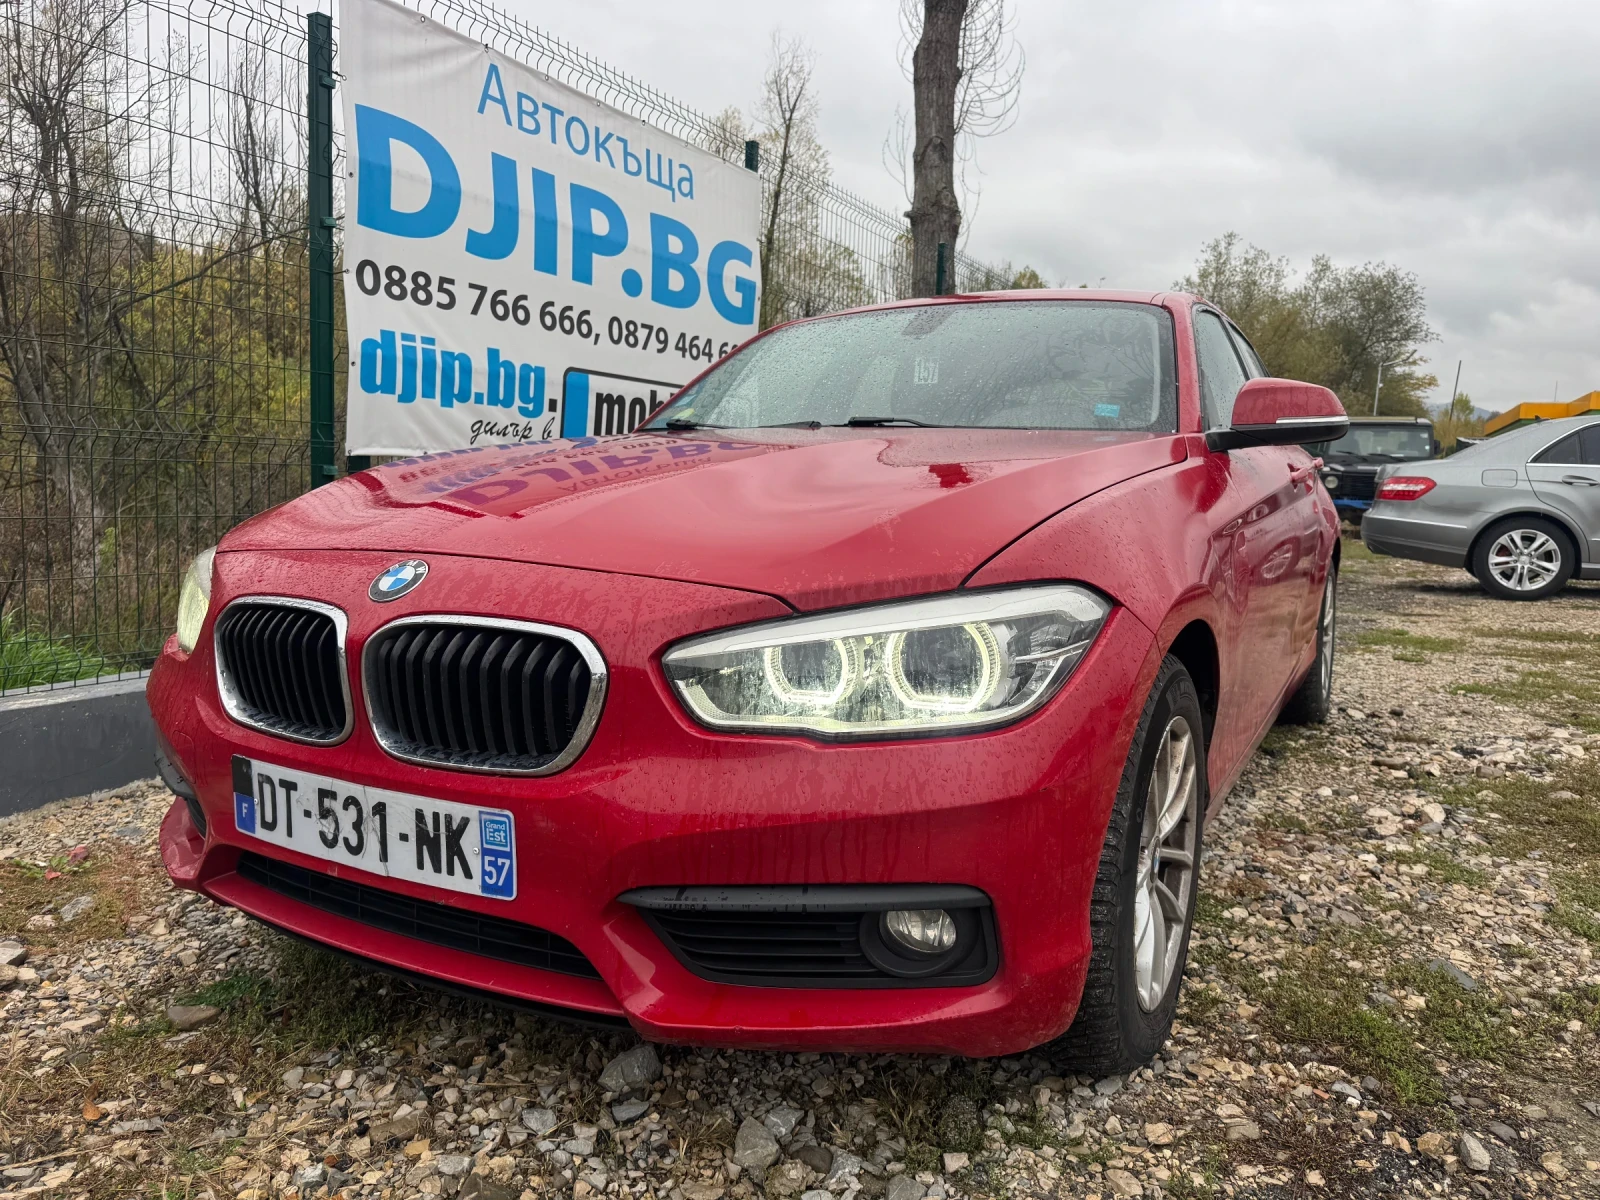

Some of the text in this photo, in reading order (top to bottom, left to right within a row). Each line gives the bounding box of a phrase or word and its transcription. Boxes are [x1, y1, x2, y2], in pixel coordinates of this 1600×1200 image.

[477, 63, 695, 203] Автокъща
[354, 103, 757, 326] DJIP.BG
[355, 258, 739, 363] 0885 766 666, 0879 464 6
[470, 419, 533, 445] дилър
[242, 802, 249, 818] F
[257, 772, 474, 880] DT-531-NK
[485, 821, 506, 831] Grand
[486, 828, 506, 843] Est
[484, 855, 511, 887] 57
